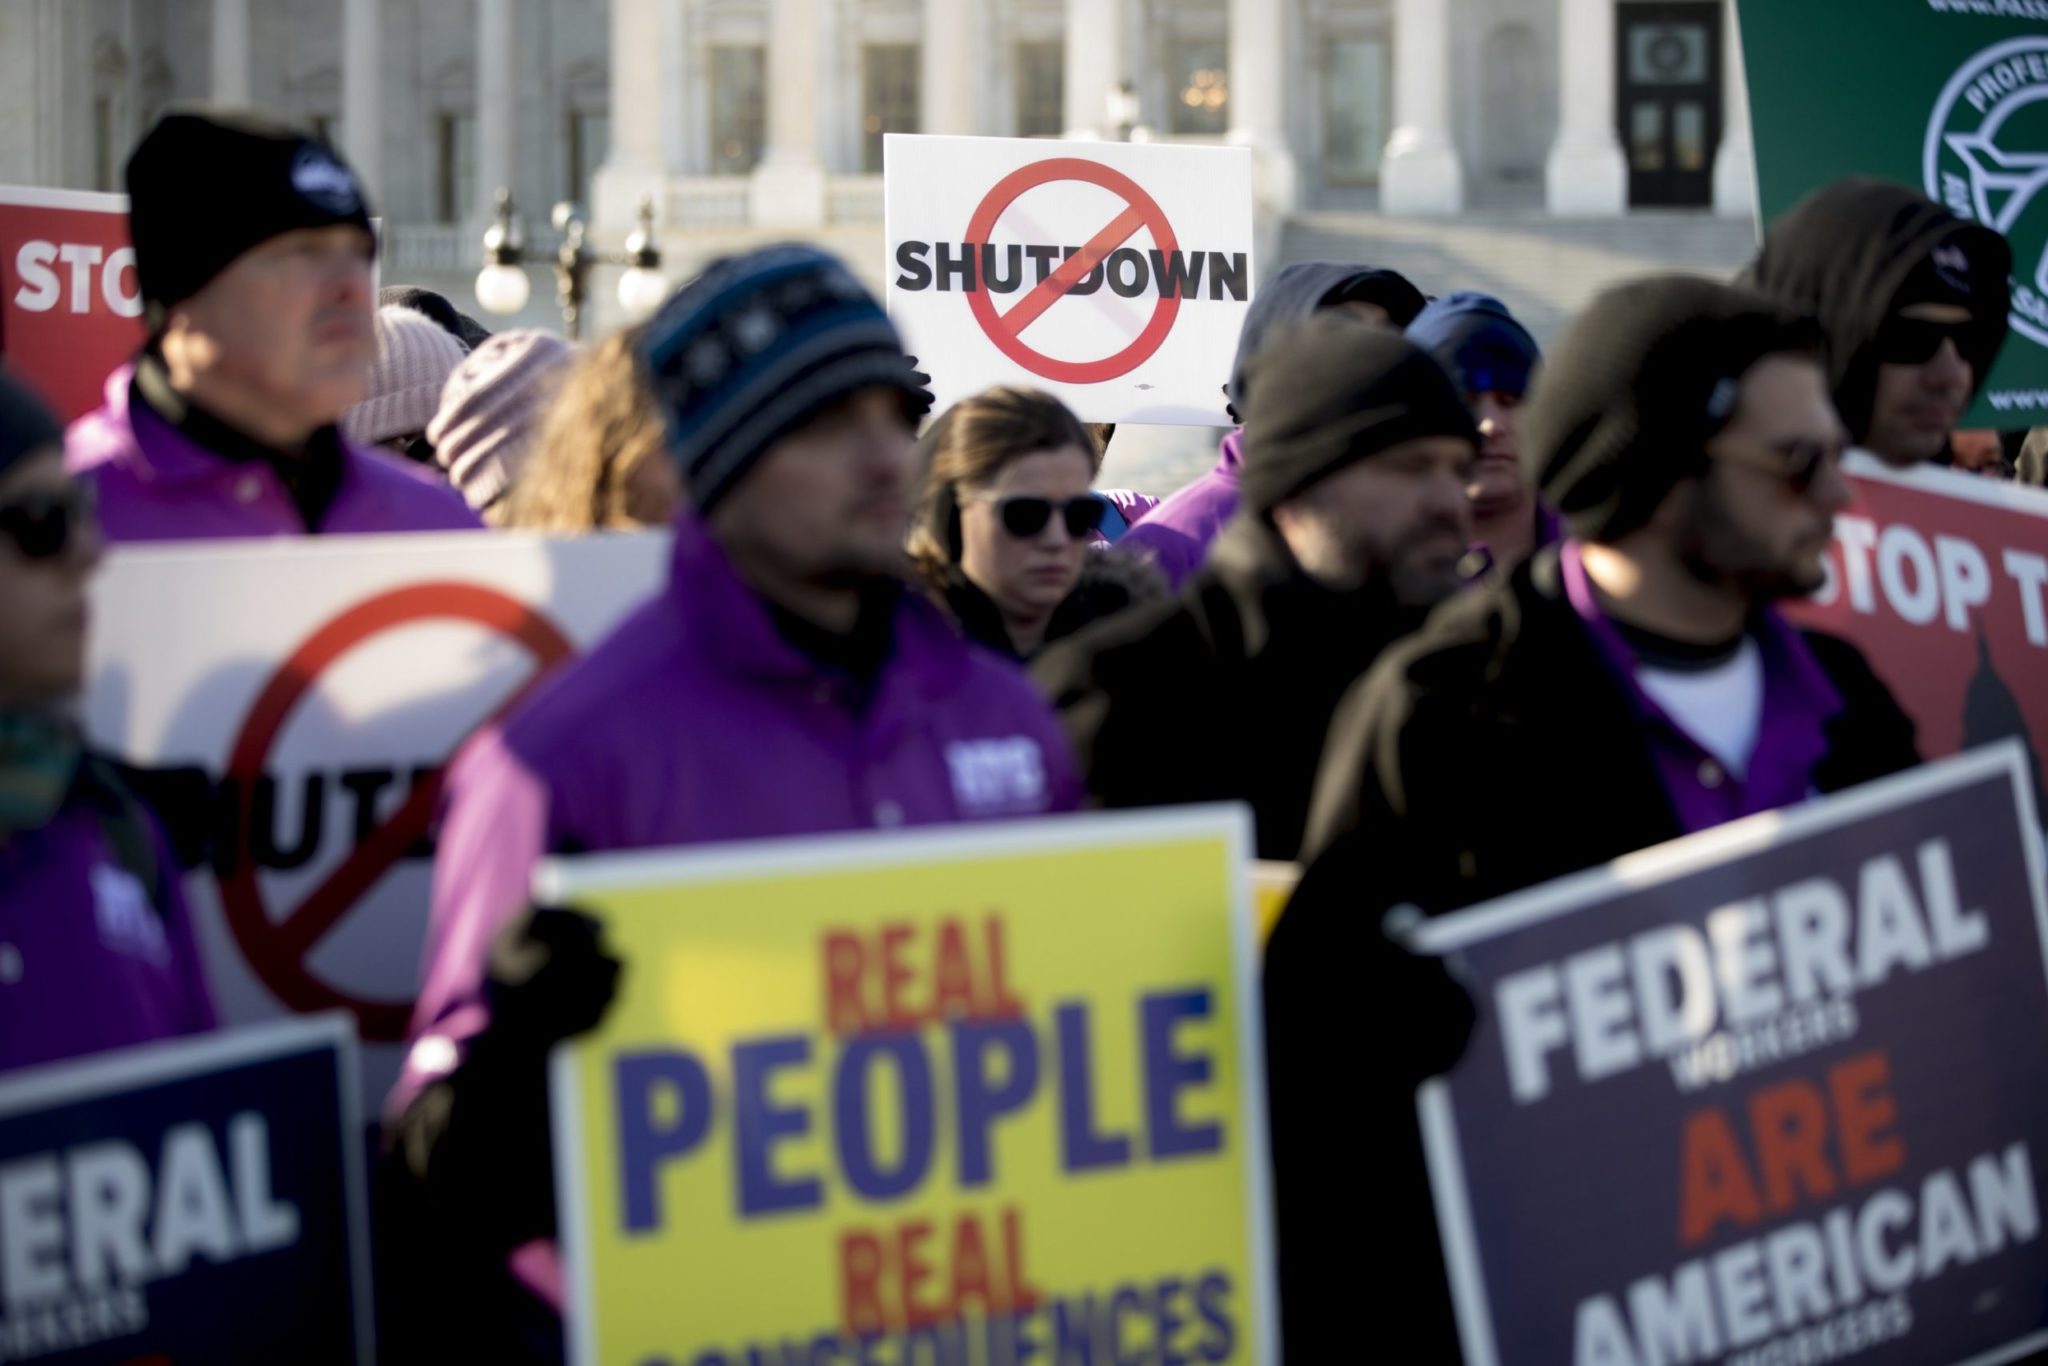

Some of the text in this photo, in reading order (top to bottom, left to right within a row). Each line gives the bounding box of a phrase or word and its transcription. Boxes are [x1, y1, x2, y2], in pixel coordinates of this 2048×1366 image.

[1963, 50, 2048, 114] PROFE
[895, 240, 1248, 301] SHUTDOWN
[822, 910, 1028, 1037] REAL
[1496, 837, 1990, 1104] FEDERAL
[610, 981, 1227, 1239] PEOPLE
[1679, 1050, 1907, 1249] ARE
[838, 1208, 1045, 1338] REAL
[1574, 1141, 2043, 1366] AMERICAN
